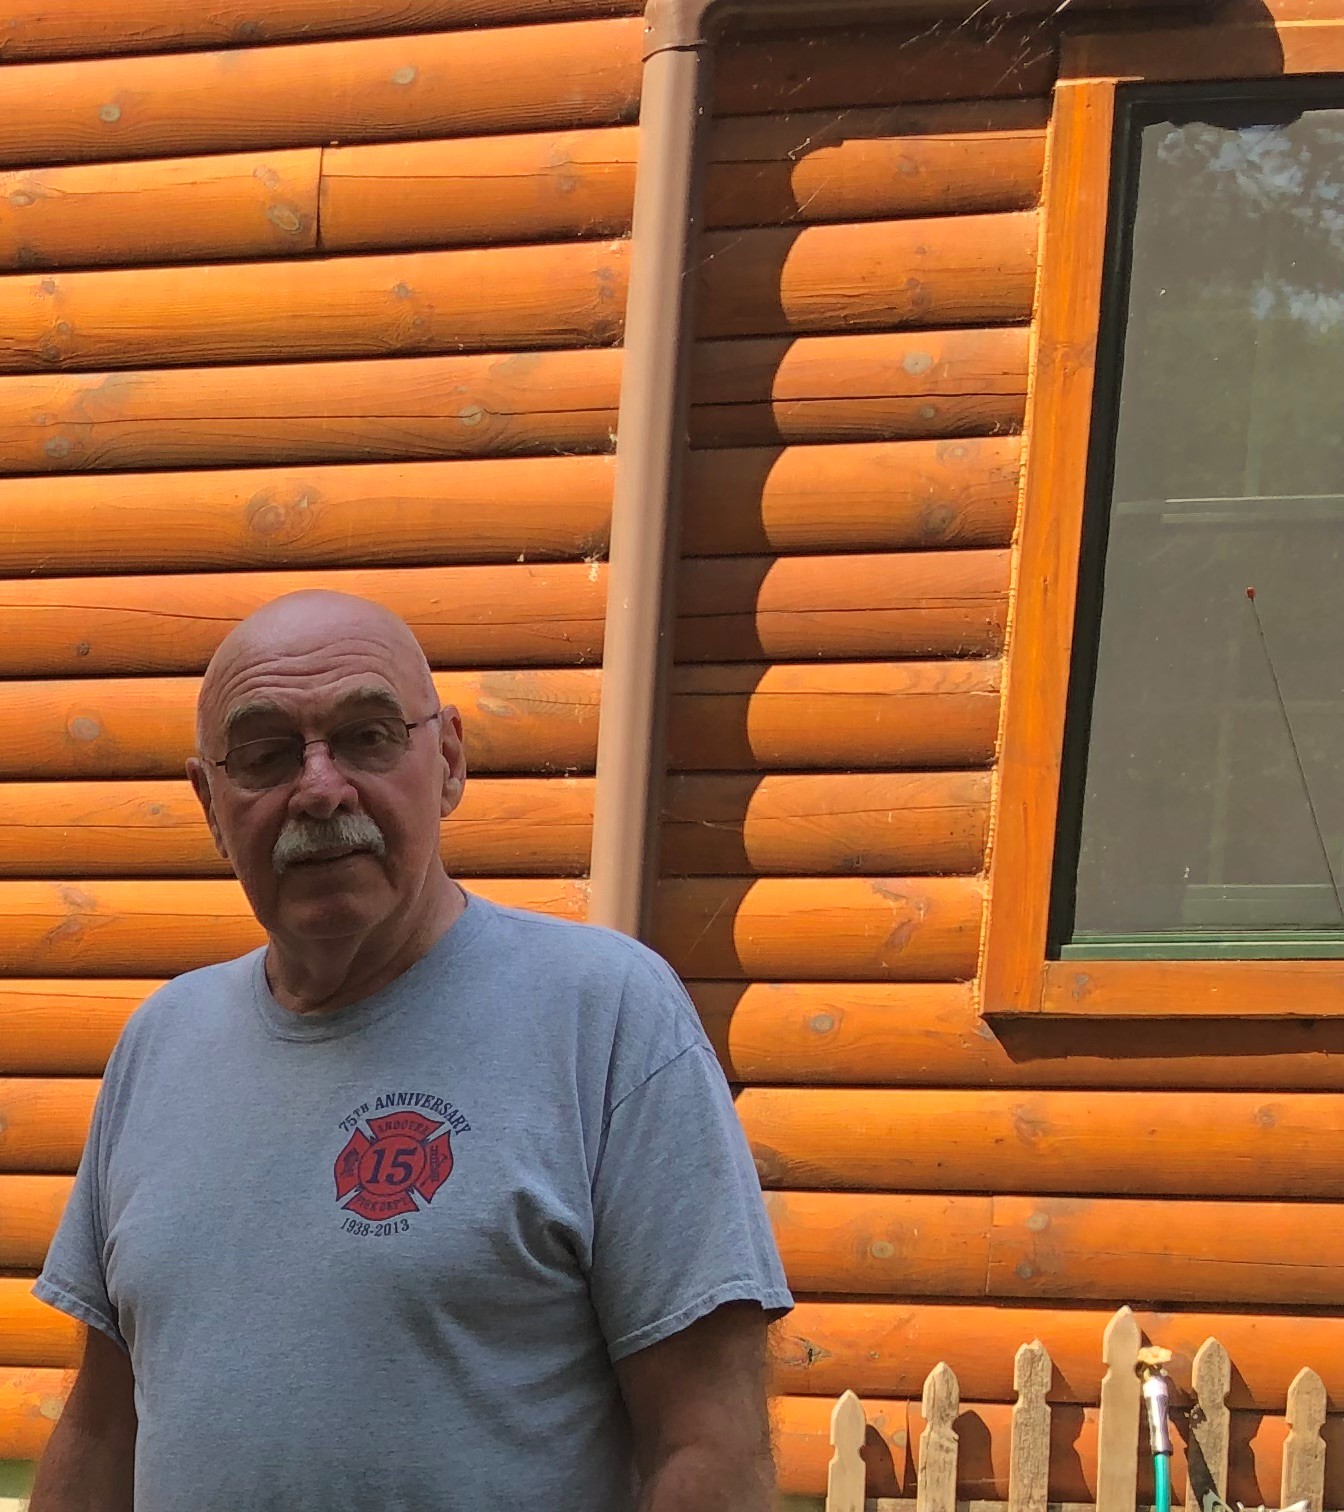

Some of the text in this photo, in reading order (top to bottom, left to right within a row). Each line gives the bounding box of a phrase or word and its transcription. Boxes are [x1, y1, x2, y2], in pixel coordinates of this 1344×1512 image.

[339, 1092, 471, 1135] 75TH ANNIVERSARY
[366, 1147, 418, 1186] 15
[340, 1217, 410, 1238] 1938-2013
